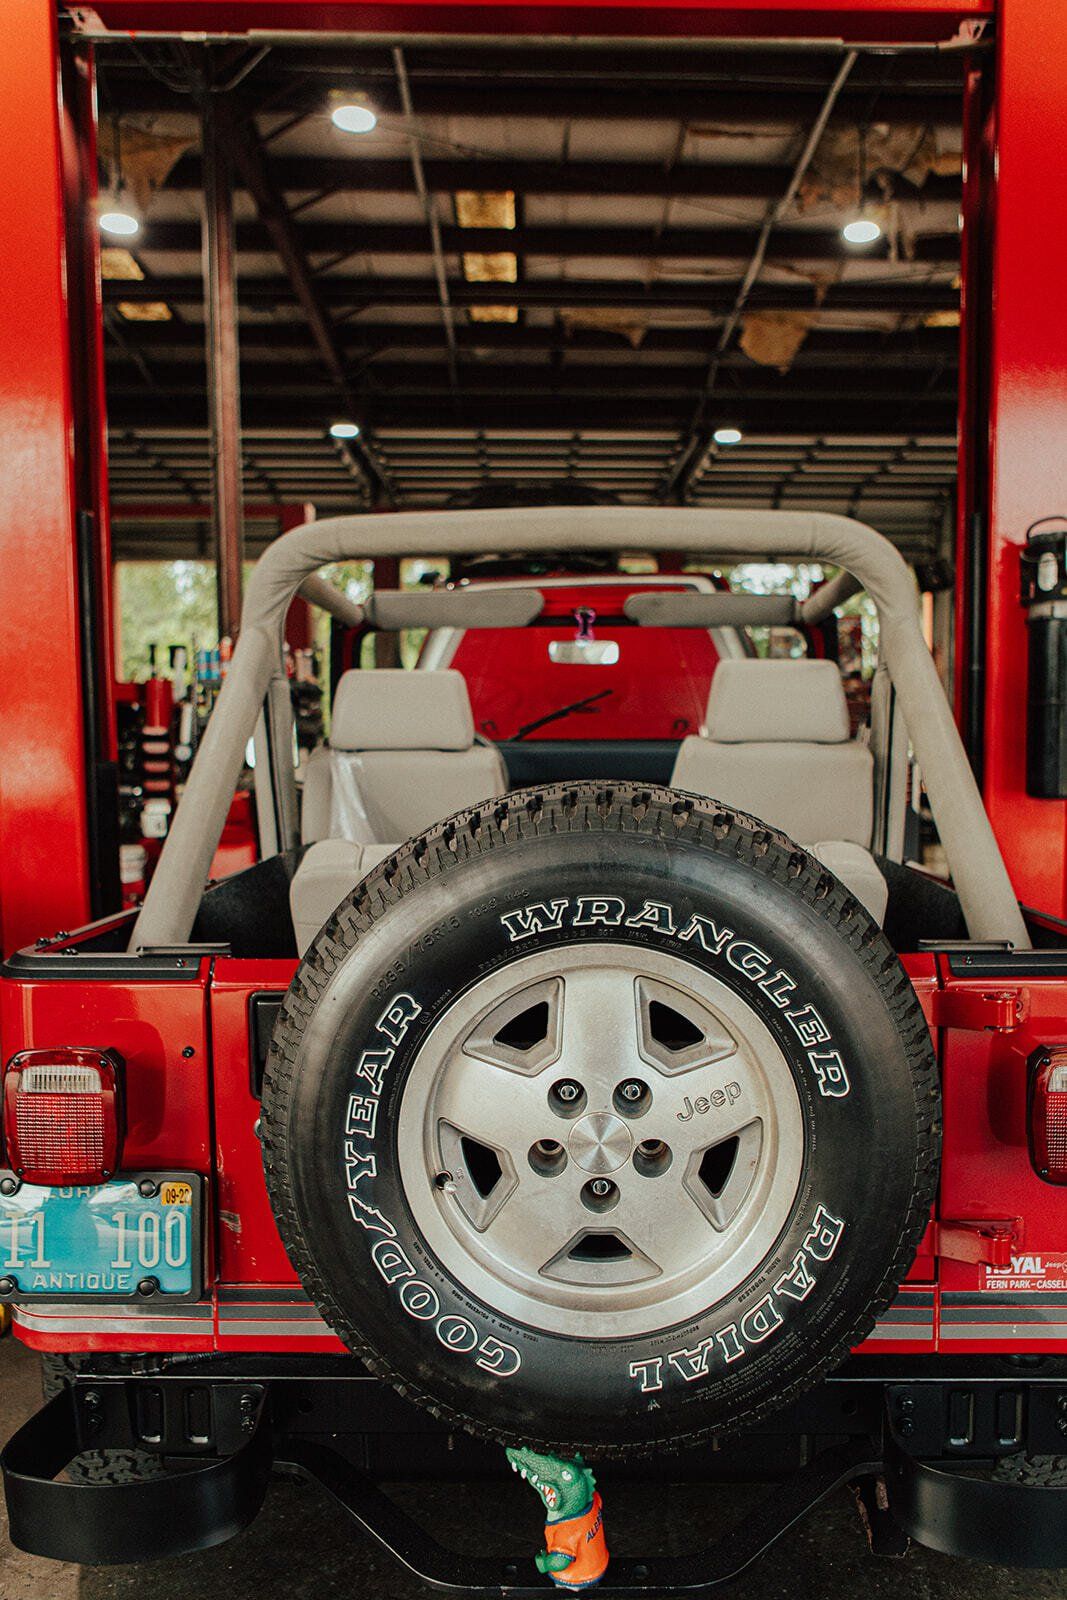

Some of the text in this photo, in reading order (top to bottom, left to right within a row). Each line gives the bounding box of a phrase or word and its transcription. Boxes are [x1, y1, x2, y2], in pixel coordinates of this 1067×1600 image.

[501, 896, 851, 1098] WRANGLER
[677, 1081, 742, 1122] Jeep
[111, 1211, 188, 1269] 100
[32, 1273, 131, 1290] ANTIQUE
[629, 1203, 846, 1393] RADIAL
[986, 1279, 1008, 1289] FERN
